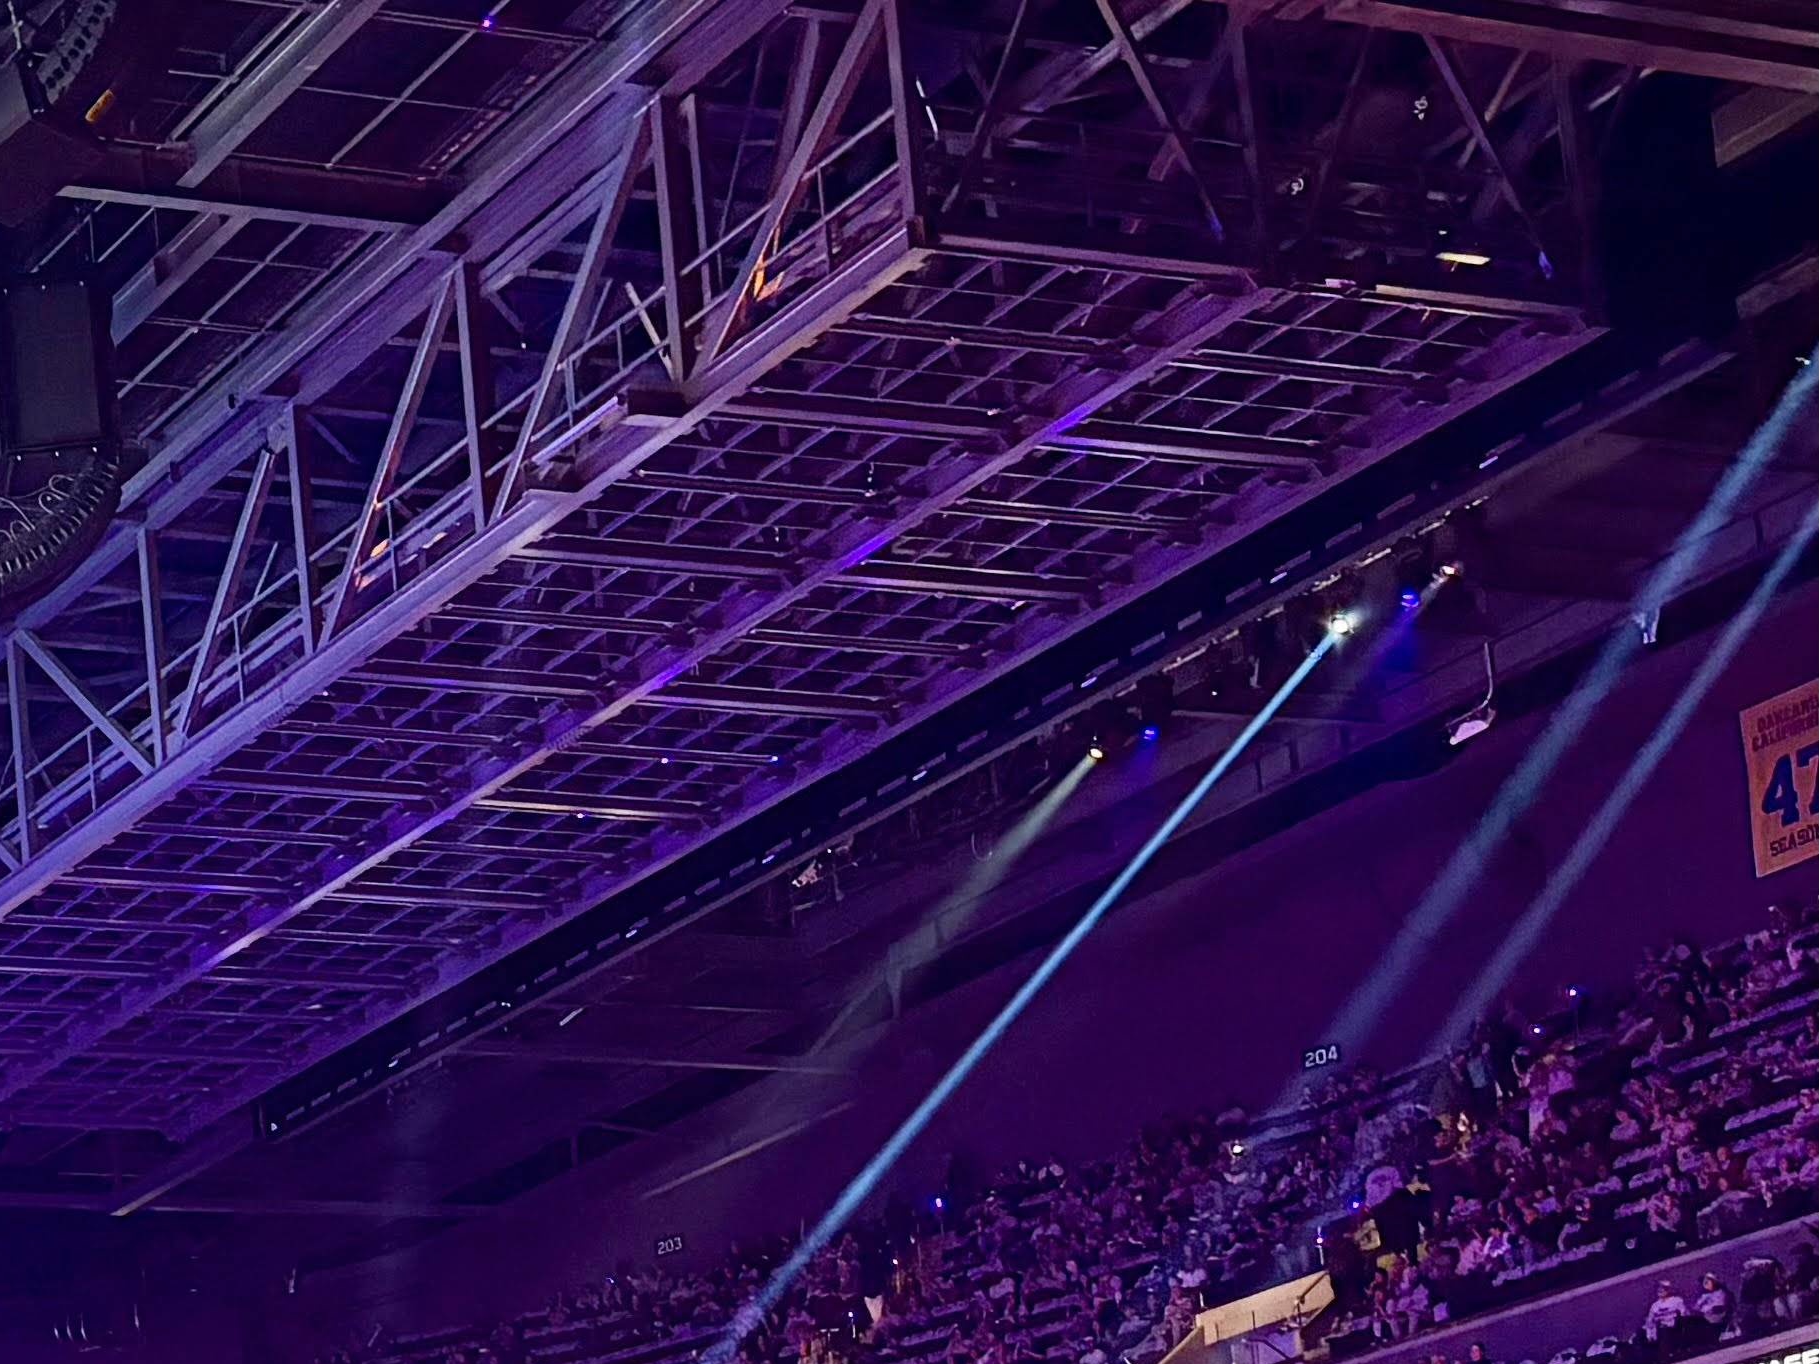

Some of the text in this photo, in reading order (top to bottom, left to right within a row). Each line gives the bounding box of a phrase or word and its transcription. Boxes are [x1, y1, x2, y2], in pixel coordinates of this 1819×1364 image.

[1762, 744, 1819, 828] 47
[1305, 1045, 1338, 1068] 204
[657, 1237, 683, 1255] 203
